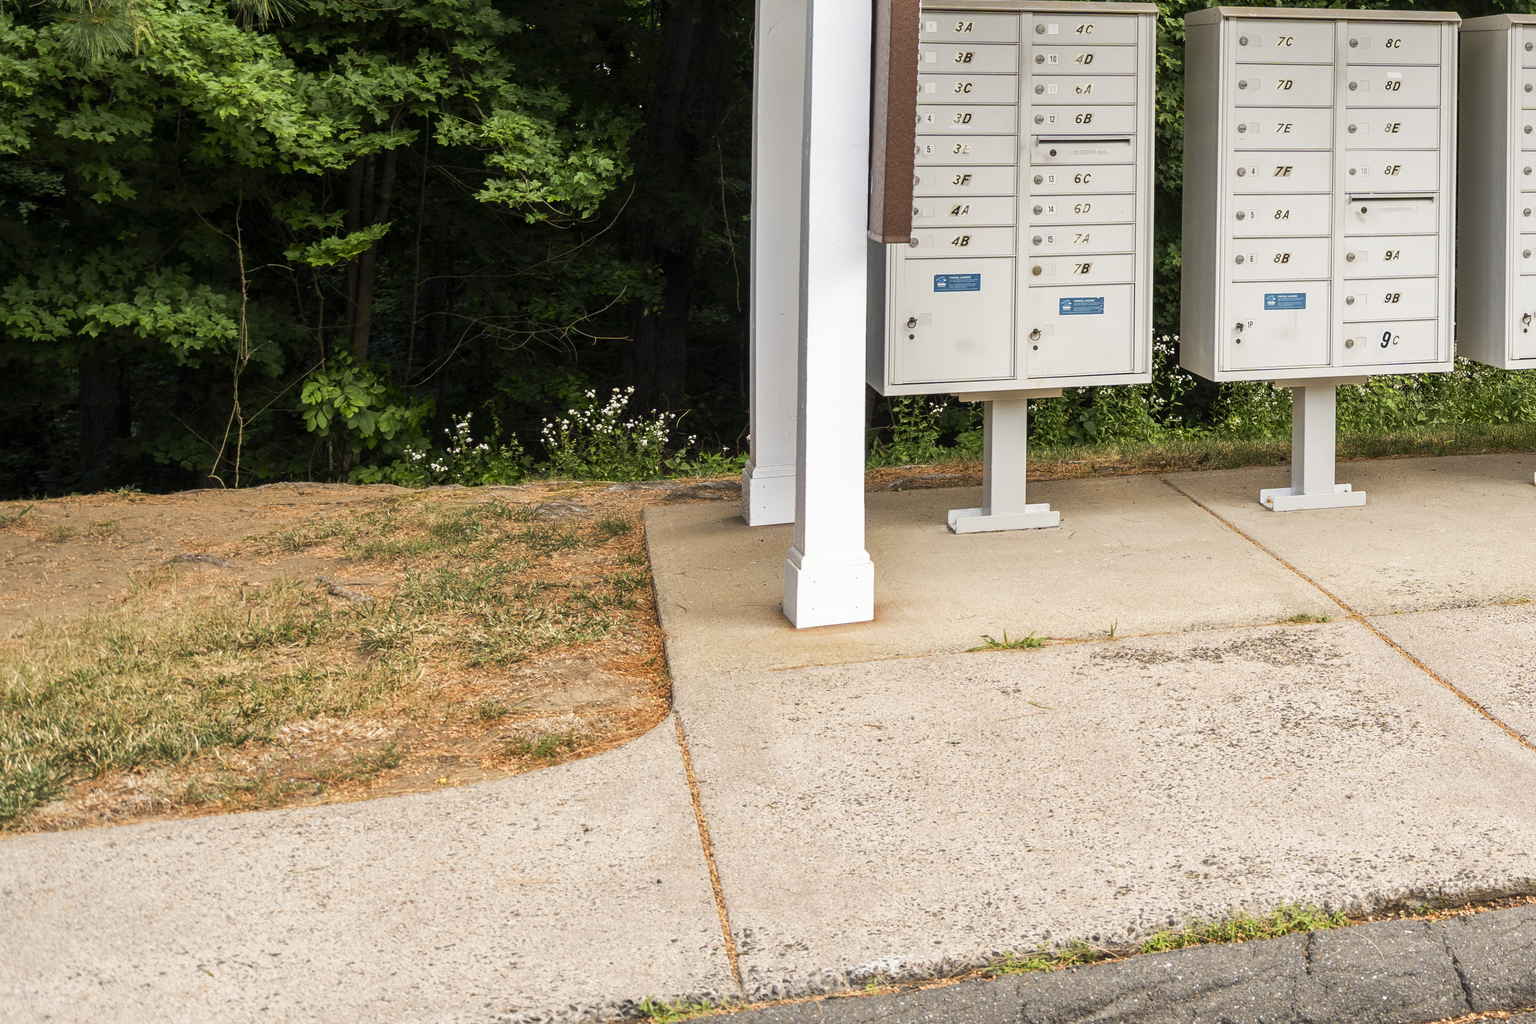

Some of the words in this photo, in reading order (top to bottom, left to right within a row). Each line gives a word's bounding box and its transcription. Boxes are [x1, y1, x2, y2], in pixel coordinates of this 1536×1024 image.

[955, 22, 972, 32] 3A
[1076, 24, 1094, 35] 4C
[1278, 37, 1293, 46] 7C
[1385, 39, 1401, 48] 8C
[955, 52, 973, 63] 3B
[1050, 55, 1057, 63] 10
[1075, 54, 1094, 65] 4D
[954, 83, 972, 93] 3C
[1076, 84, 1092, 94] 6A
[1277, 80, 1293, 90] 7D
[1385, 81, 1401, 91] 8D
[953, 113, 972, 124] 3D
[1075, 114, 1092, 124] 6B
[1276, 124, 1292, 133] 7E
[1384, 123, 1401, 133] 8E
[953, 144, 972, 154] 3E
[1275, 166, 1292, 176] 7F
[1384, 165, 1401, 175] 8F
[952, 175, 972, 186] 3F
[1074, 174, 1092, 184] 6C
[951, 205, 970, 216] 4A
[1074, 204, 1091, 214] 6D
[1274, 210, 1290, 220] 8A
[951, 236, 970, 246] 4B
[1074, 234, 1090, 244] 7A
[1274, 254, 1290, 264] 8B
[1385, 251, 1400, 261] 9A
[1074, 264, 1090, 274] 7B
[1384, 293, 1400, 303] 9B
